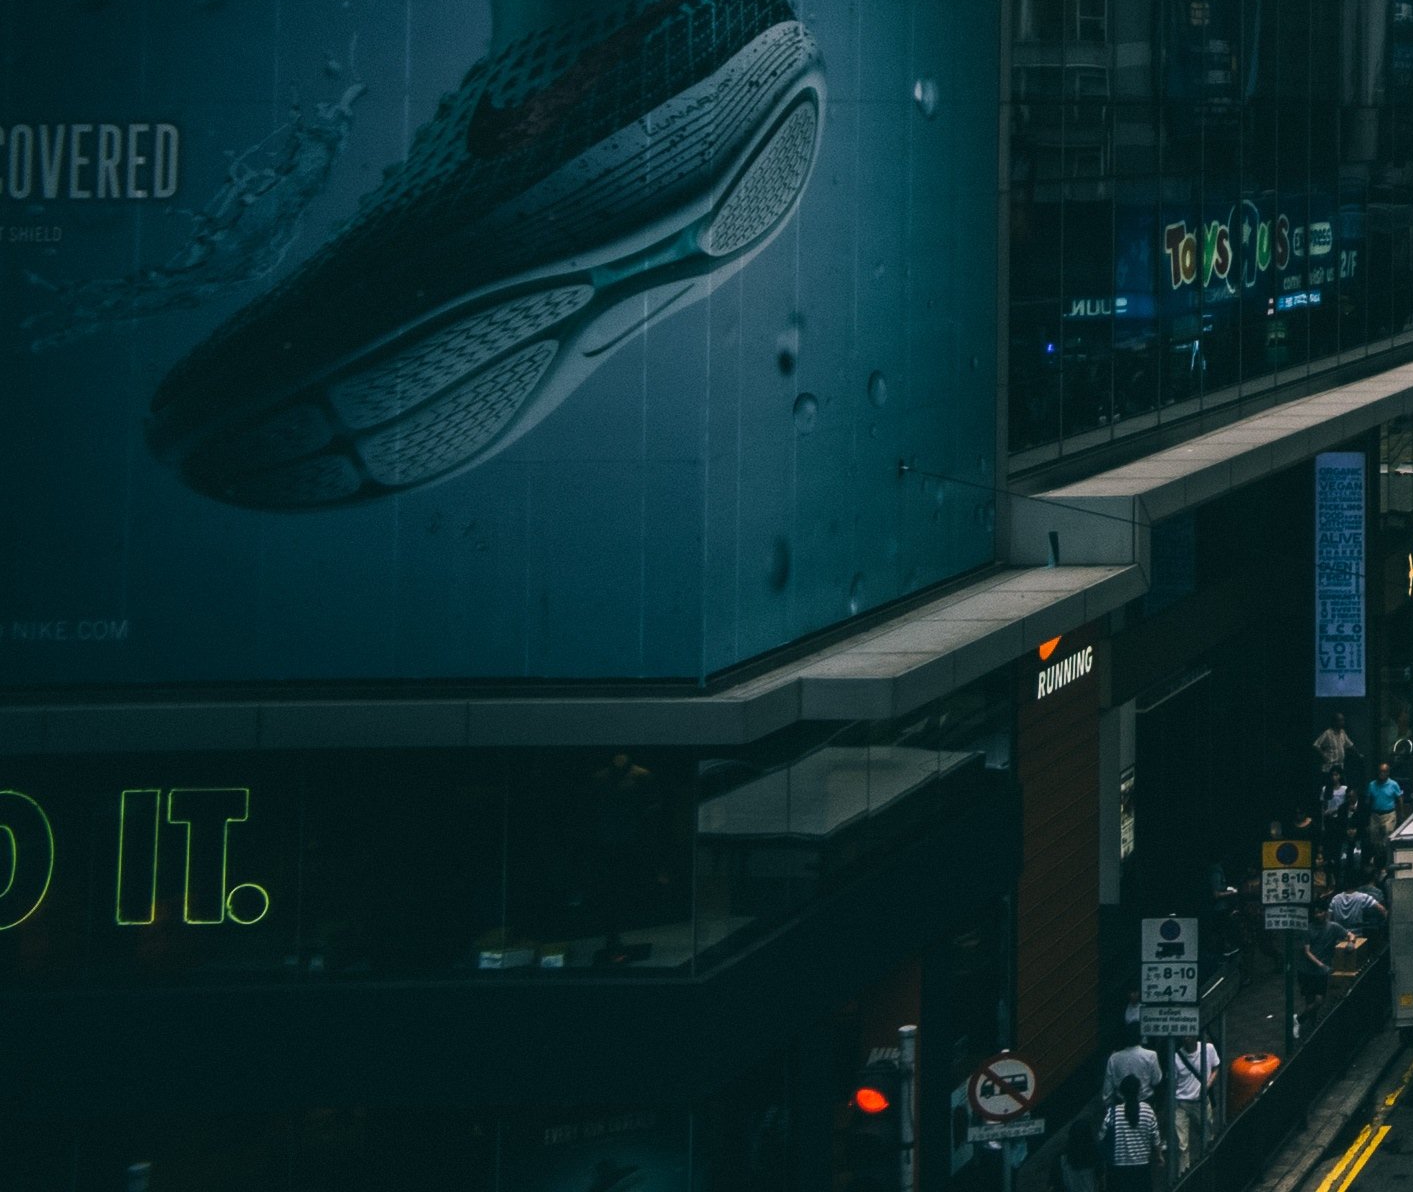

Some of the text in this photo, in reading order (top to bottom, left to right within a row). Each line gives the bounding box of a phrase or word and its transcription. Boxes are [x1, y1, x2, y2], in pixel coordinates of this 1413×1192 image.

[0, 123, 180, 199] OVERED
[1320, 482, 1362, 491] VEGAN
[1320, 533, 1361, 544] ALIVE
[1319, 623, 1361, 634] ECO
[1037, 645, 1093, 700] RUNNING
[116, 789, 270, 925] IT.
[1163, 968, 1196, 979] 8-10
[1163, 986, 1188, 997] 4-7
